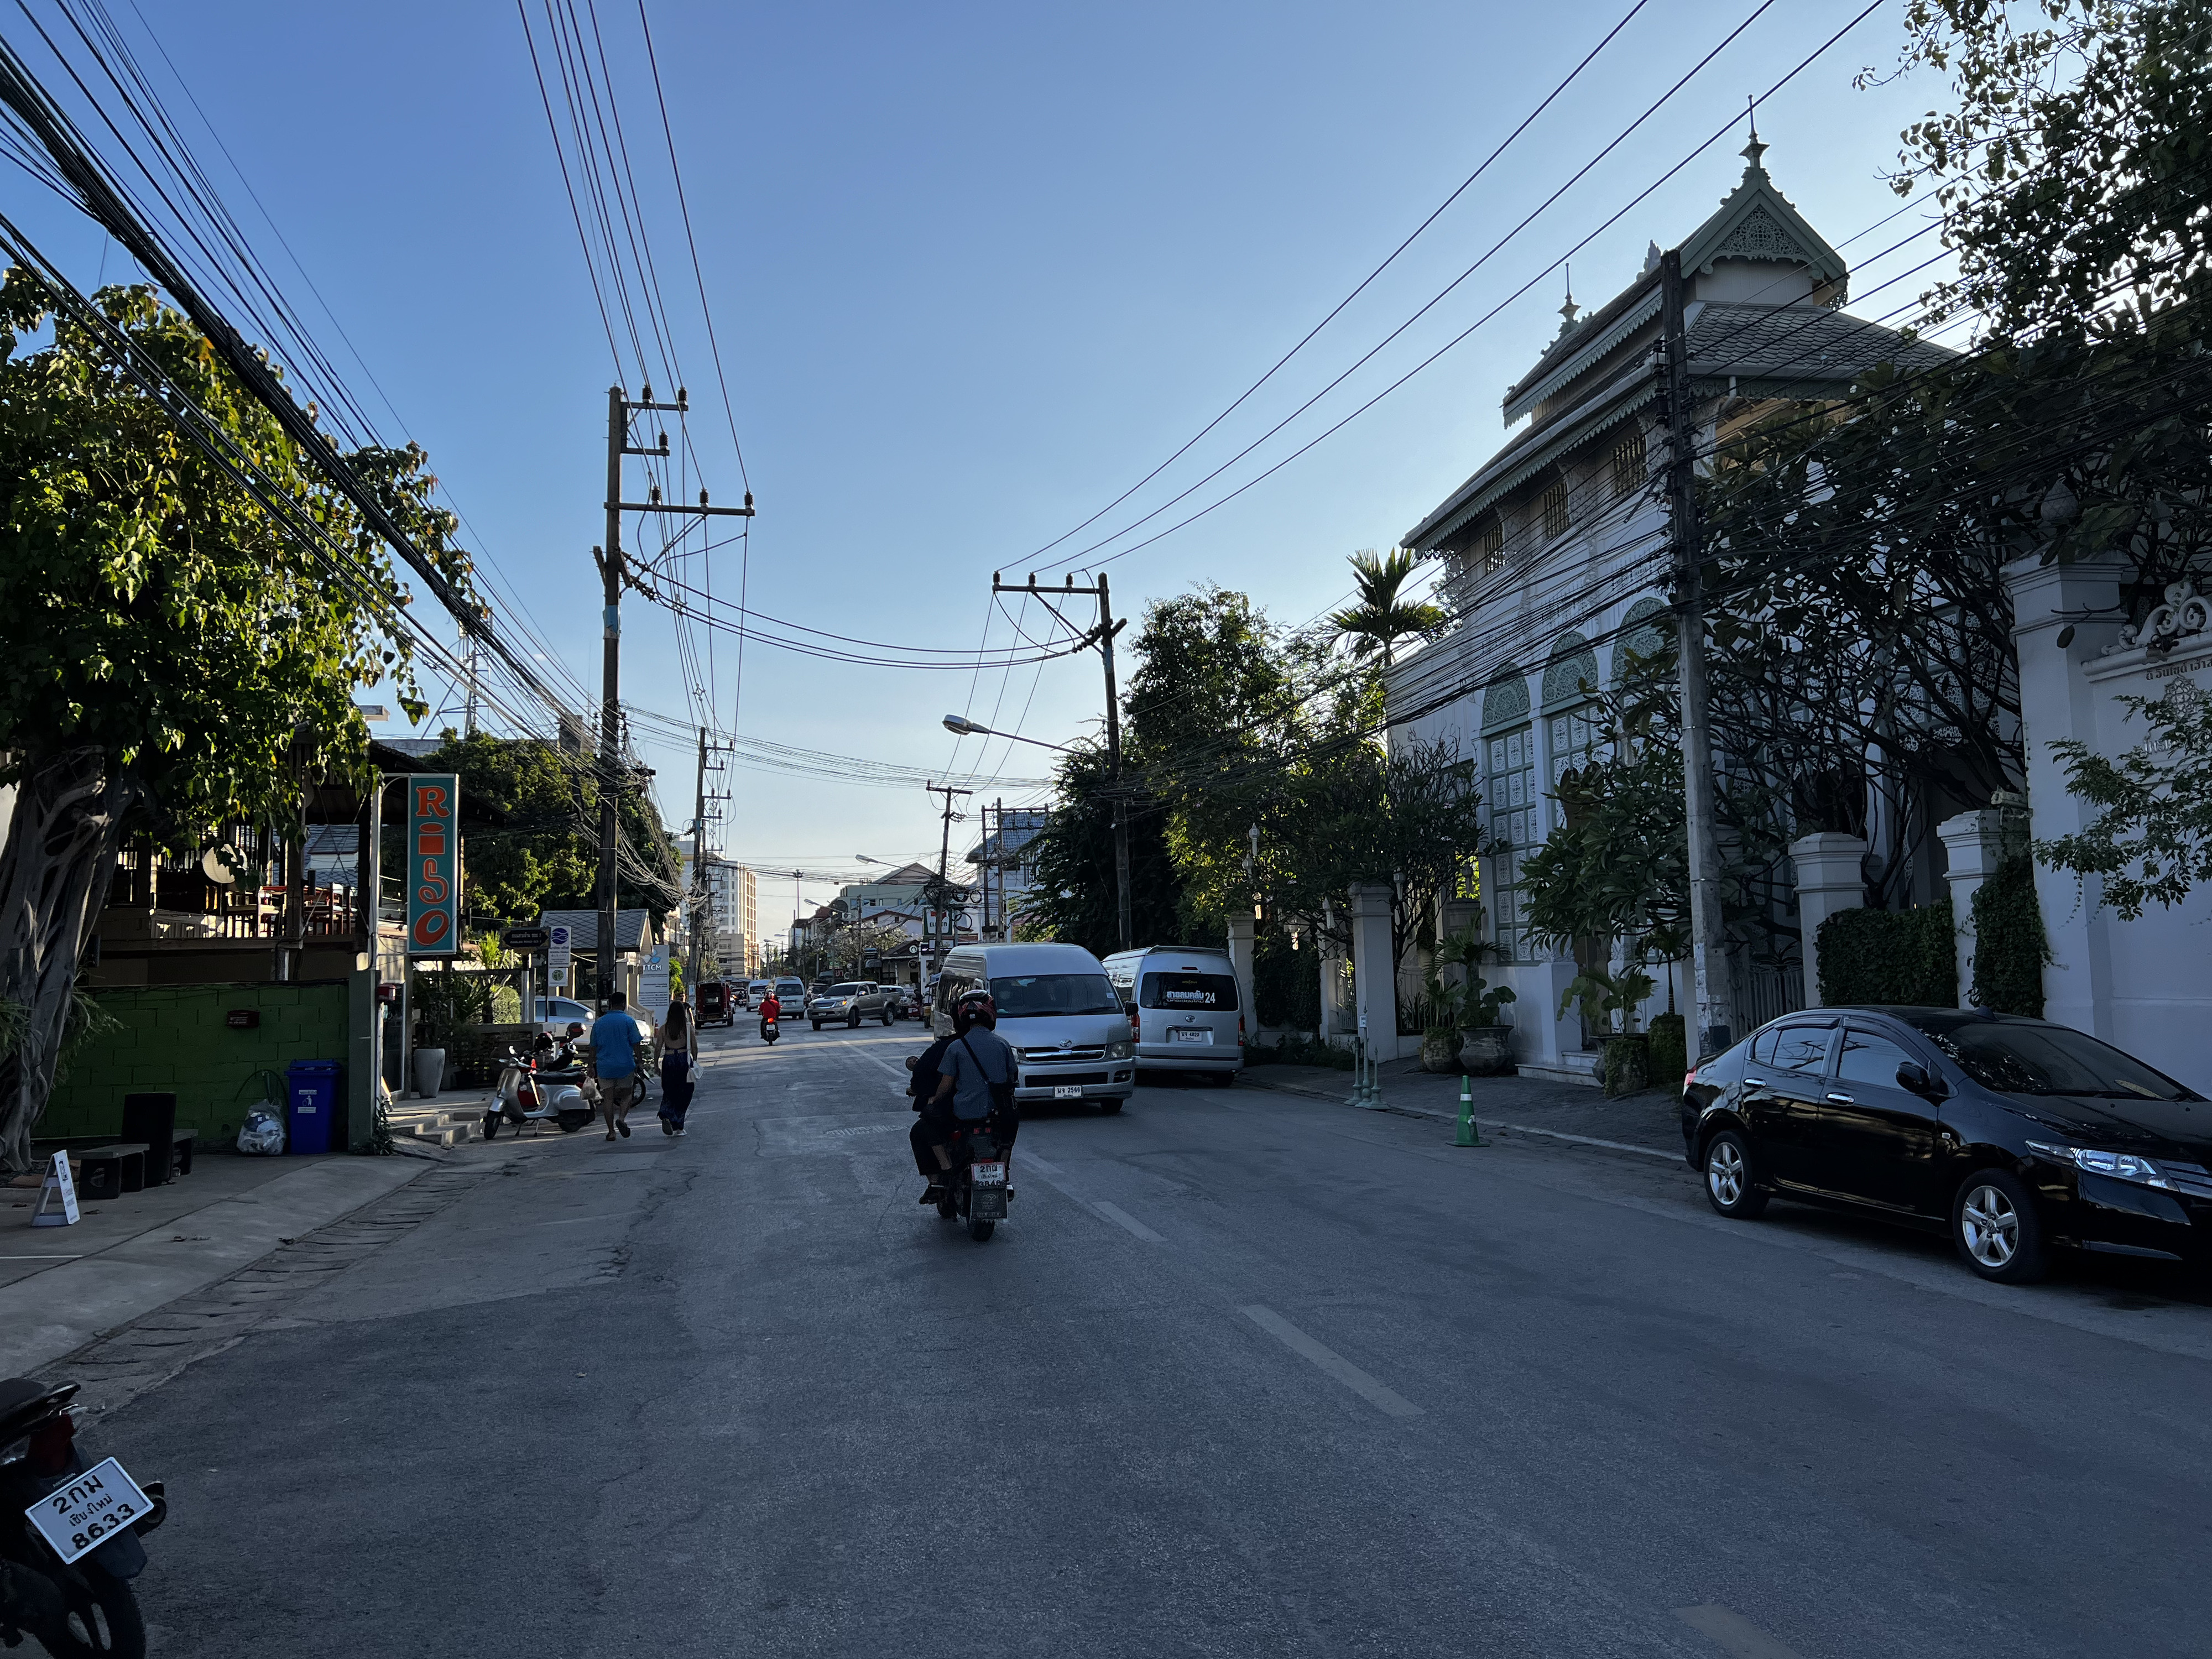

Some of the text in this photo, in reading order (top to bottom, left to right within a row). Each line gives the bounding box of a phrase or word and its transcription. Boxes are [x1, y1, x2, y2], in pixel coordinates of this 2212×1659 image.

[1204, 992, 1216, 1004] 24
[53, 1475, 103, 1515] 2กม
[69, 1493, 113, 1526] เชียงใหม่
[72, 1504, 135, 1549] 8633
